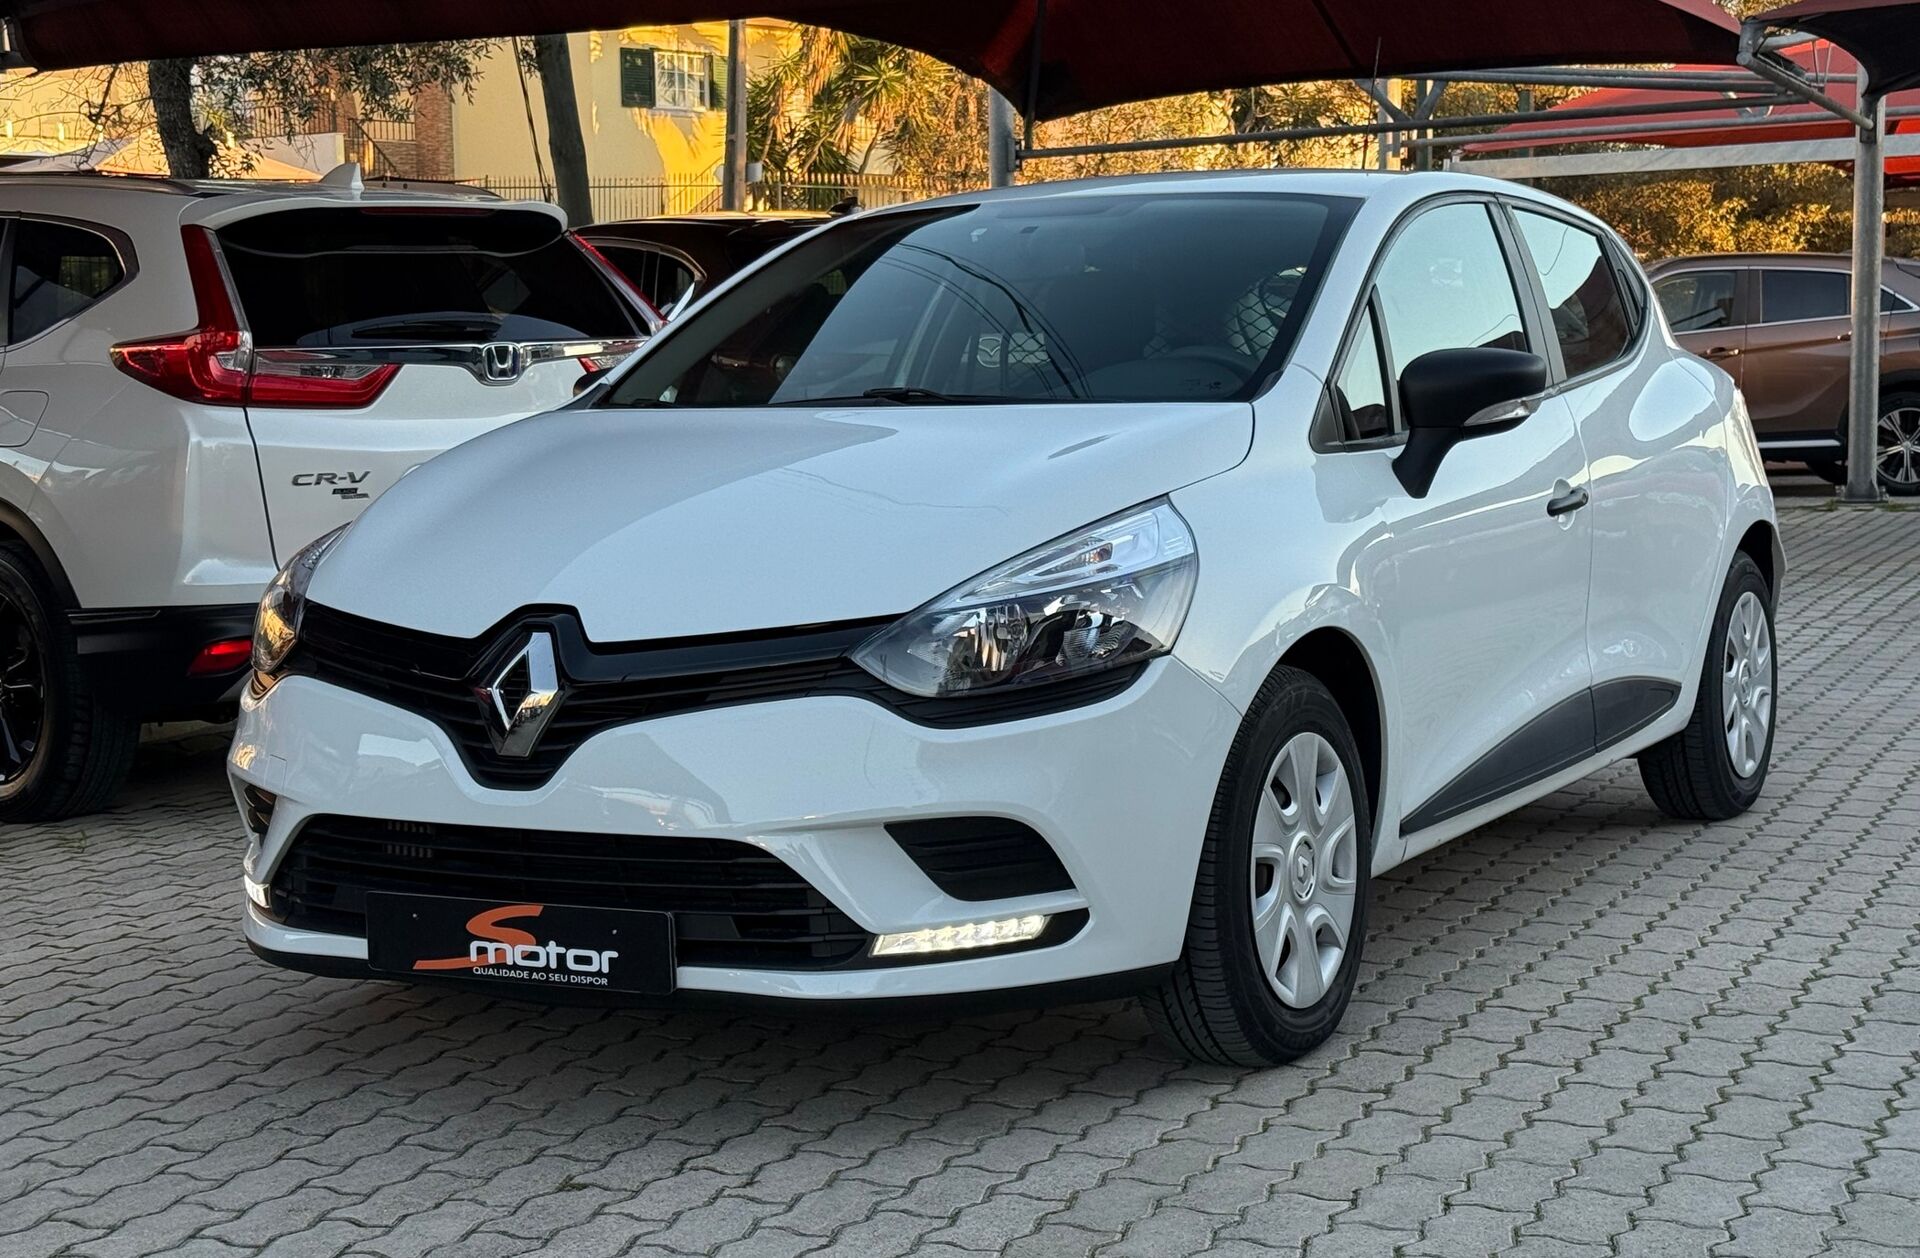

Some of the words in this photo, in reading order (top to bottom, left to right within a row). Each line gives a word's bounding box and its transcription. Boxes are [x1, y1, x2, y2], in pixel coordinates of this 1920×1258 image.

[291, 470, 371, 487] CR-V
[470, 940, 619, 974] motor
[473, 966, 529, 980] QUALIDADE
[531, 972, 547, 981] AO
[548, 973, 568, 983] SEU
[570, 975, 608, 986] DISPOR
